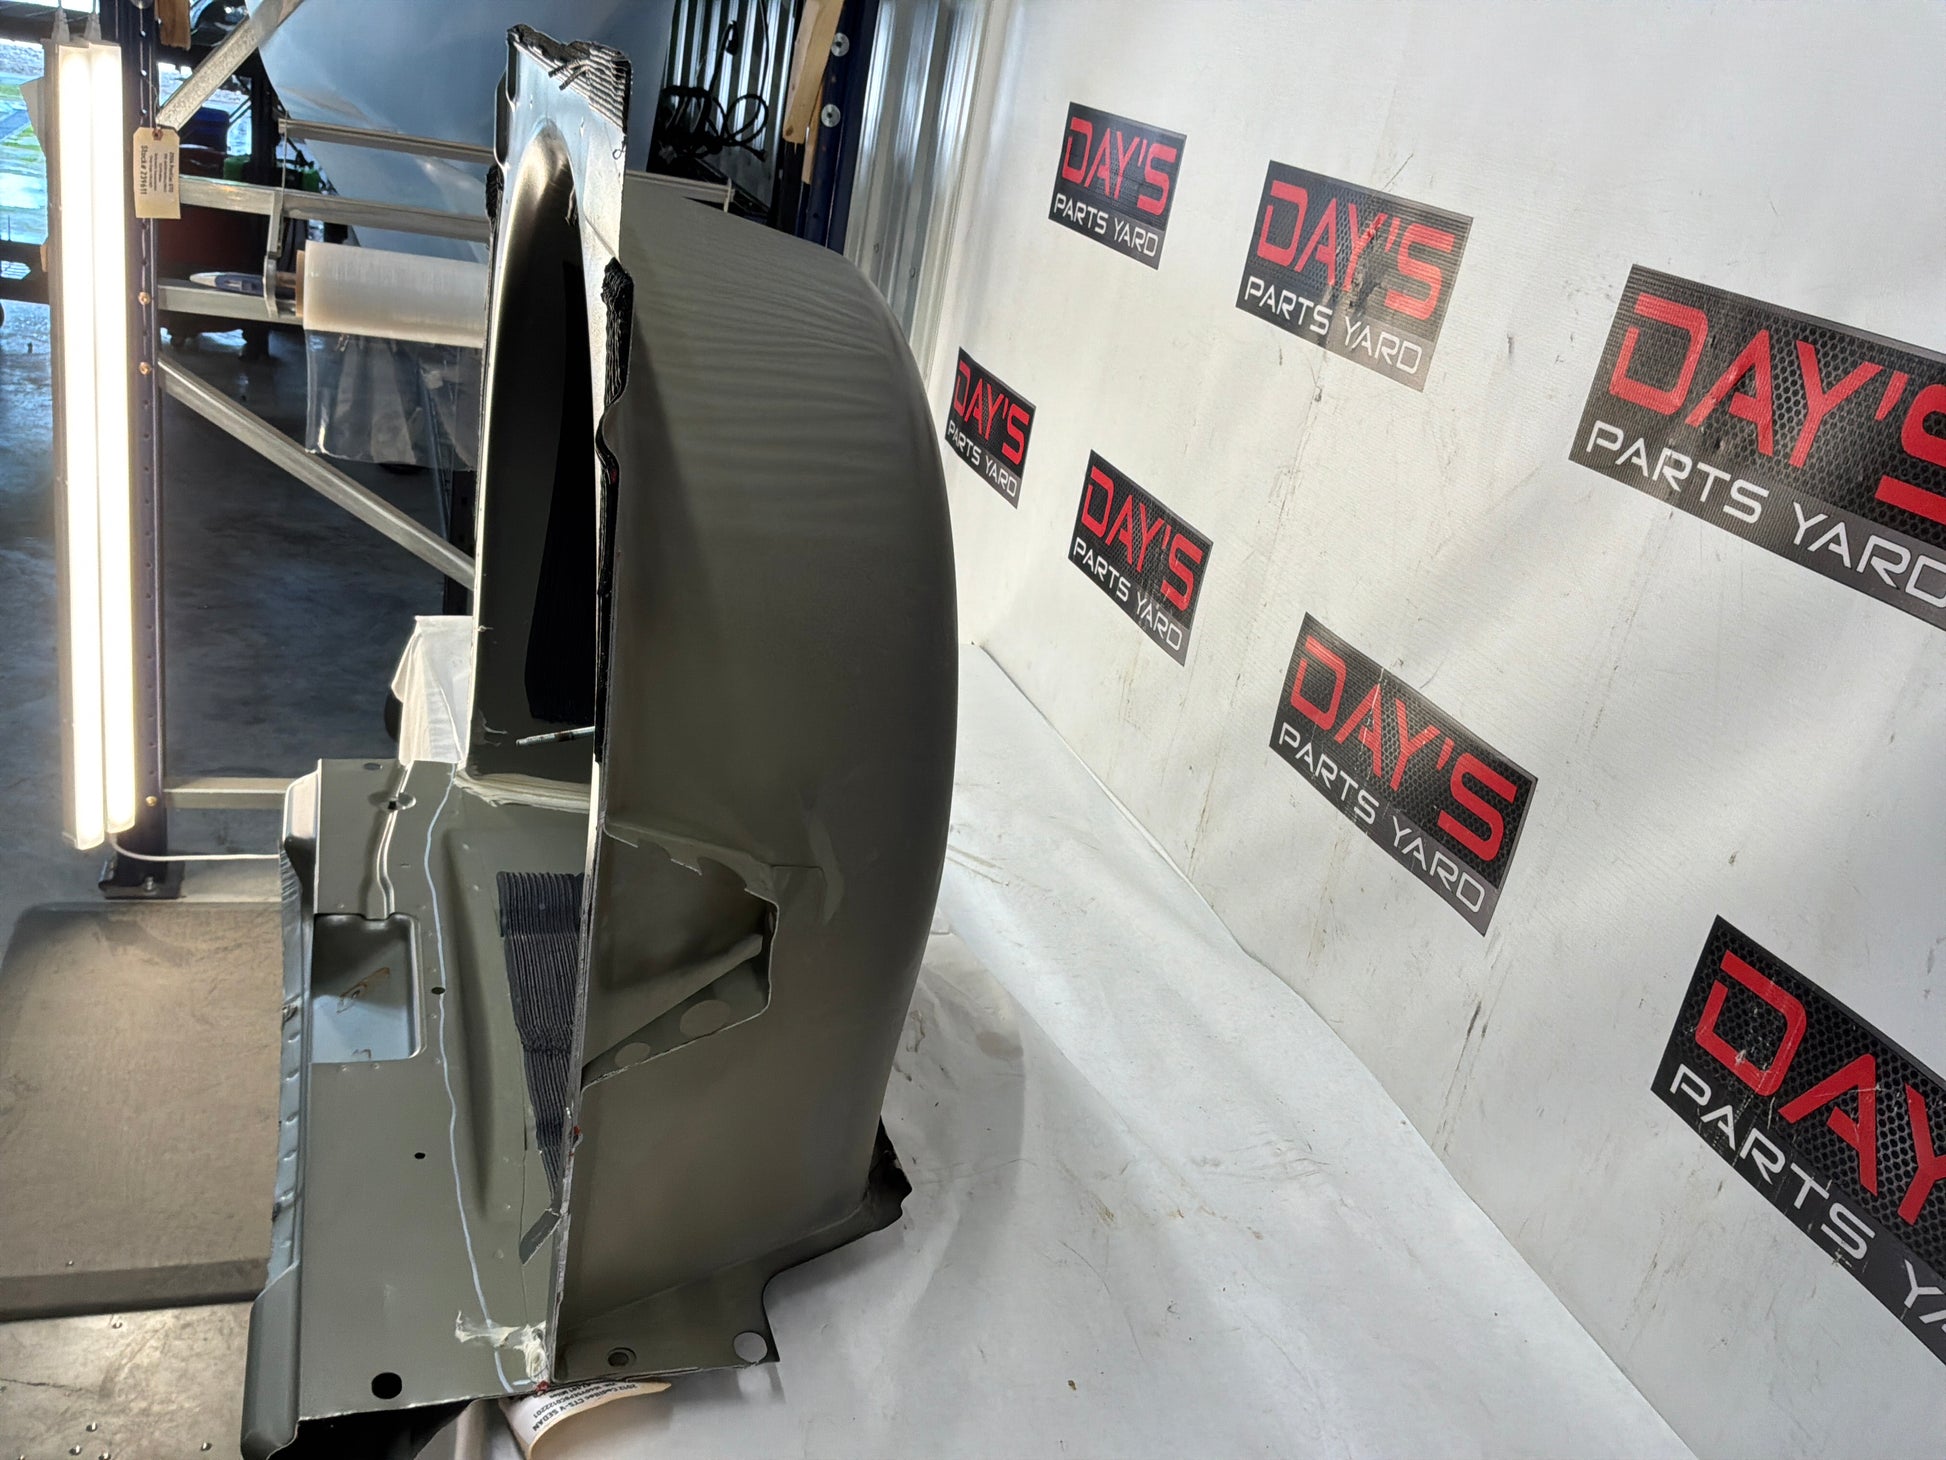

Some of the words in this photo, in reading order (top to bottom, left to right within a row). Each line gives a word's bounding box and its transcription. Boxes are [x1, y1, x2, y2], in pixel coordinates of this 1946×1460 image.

[1061, 117, 1177, 216] DAY'S
[1054, 193, 1108, 234] PARTS
[1114, 217, 1158, 257] YARD
[1256, 180, 1455, 321] DAY'S
[1244, 276, 1333, 336] PARTS
[1343, 315, 1423, 374] YARD
[947, 419, 982, 467] PARTS
[985, 455, 1018, 498] YARD
[953, 360, 1030, 465] DAY'S
[1081, 465, 1203, 611] DAY'S
[1586, 420, 1769, 524] PARTS
[1793, 501, 1946, 608] YARD
[1073, 537, 1131, 602] PARTS
[1135, 591, 1182, 651] YARD
[1290, 635, 1518, 862] DAY'S
[1278, 722, 1380, 825] PARTS
[1392, 815, 1486, 913] YARD
[1669, 1063, 1876, 1260] PARTS
[532, 1410, 559, 1432] SEDAN
[560, 1398, 585, 1412] CTS-V
[584, 1387, 618, 1400] Cadillac
